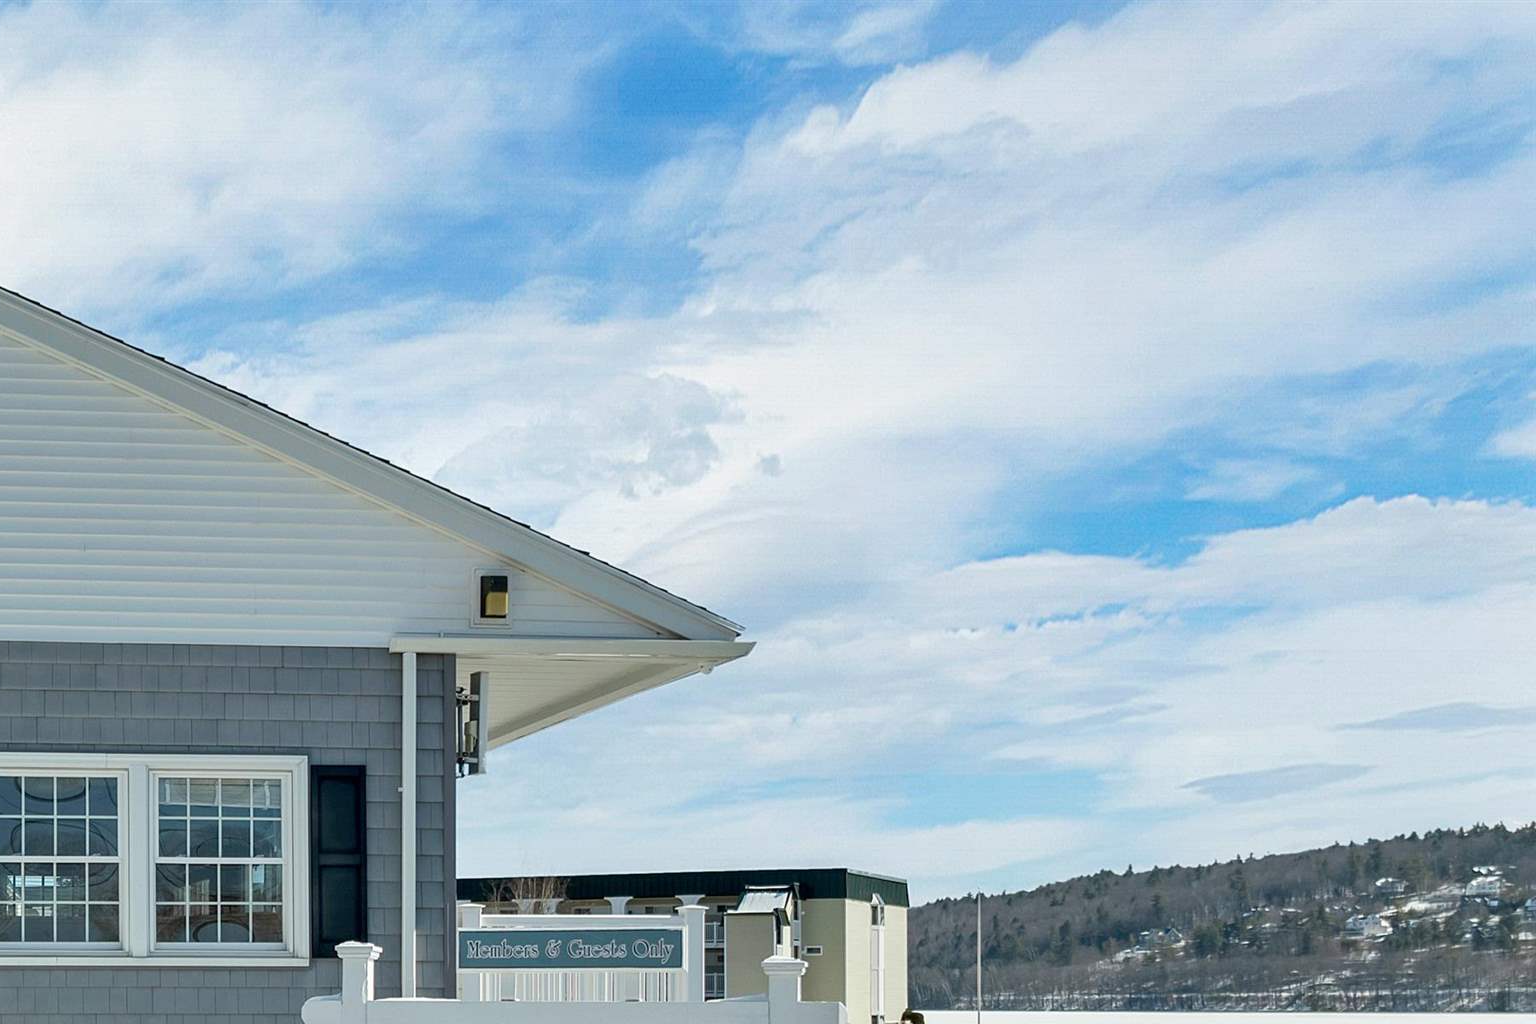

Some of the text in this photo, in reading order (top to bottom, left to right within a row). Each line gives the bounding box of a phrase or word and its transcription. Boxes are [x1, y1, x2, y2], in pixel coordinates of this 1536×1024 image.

[466, 938, 674, 963] Members & Guests Only
